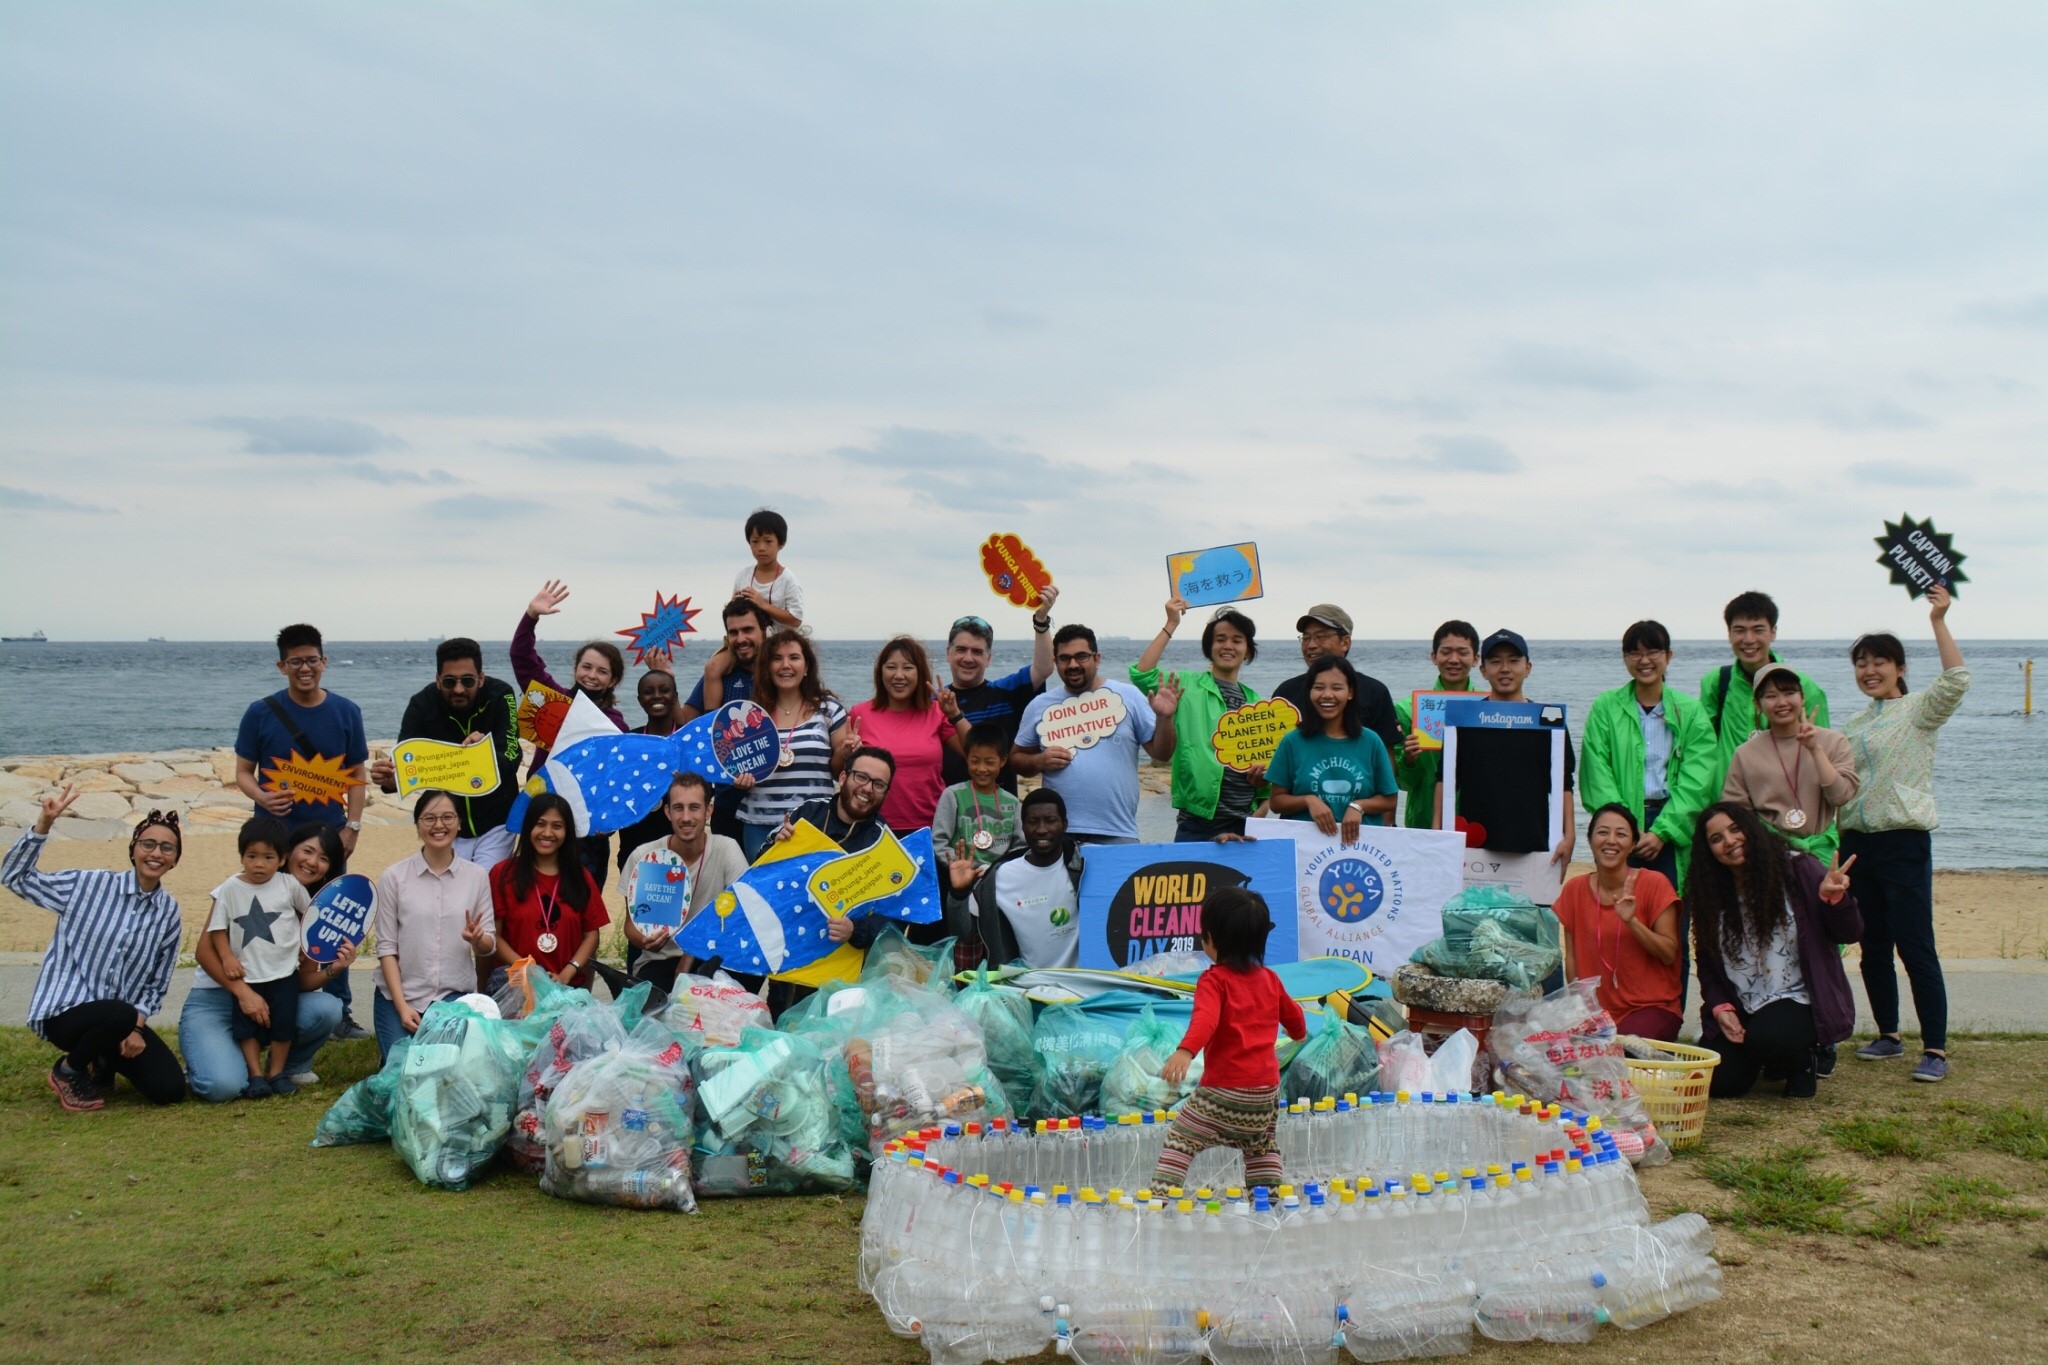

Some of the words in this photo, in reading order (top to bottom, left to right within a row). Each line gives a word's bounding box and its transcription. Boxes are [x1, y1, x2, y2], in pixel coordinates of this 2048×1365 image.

[1907, 530, 1954, 575] CAPTAIN
[995, 540, 1019, 575] YUNGA
[1017, 571, 1039, 600] TRIBE
[1888, 543, 1934, 589] PLANET!
[645, 620, 660, 638] JOIN
[657, 611, 672, 624] OUR
[1048, 706, 1077, 722] JOIN
[1080, 698, 1109, 714] OUR
[1227, 717, 1235, 726] A
[1237, 709, 1275, 724] GREEN
[1478, 711, 1533, 728] Instagram
[1047, 715, 1118, 742] INITIATIVE!
[1220, 725, 1262, 739] PLANET
[1266, 723, 1276, 733] IS
[1279, 721, 1287, 730] A
[730, 742, 754, 761] LOVE
[753, 736, 771, 751] THE
[1237, 737, 1274, 750] CLEAN
[281, 763, 346, 788] ENVIRONMENT
[737, 753, 768, 774] OCEAN!
[1309, 756, 1364, 781] MICHIGAN
[292, 781, 327, 797] SQUAD!
[644, 882, 662, 893] SAVE
[662, 885, 677, 894] THE
[1133, 873, 1206, 906] WORLD
[1305, 846, 1334, 877] YOUTH
[1340, 843, 1347, 851] &
[1353, 842, 1392, 867] UNITED
[1387, 870, 1402, 921] NATIONS
[1329, 862, 1381, 900] YUNGA
[331, 893, 367, 919] LET'S
[646, 893, 673, 904] OCEAN!
[319, 906, 361, 937] CLEAN
[1129, 905, 1202, 938] CLEAN
[1301, 886, 1322, 928] GLOBAL
[1326, 924, 1384, 942] ALLIANCE
[318, 925, 343, 947] UP!
[1171, 937, 1194, 952] 2019
